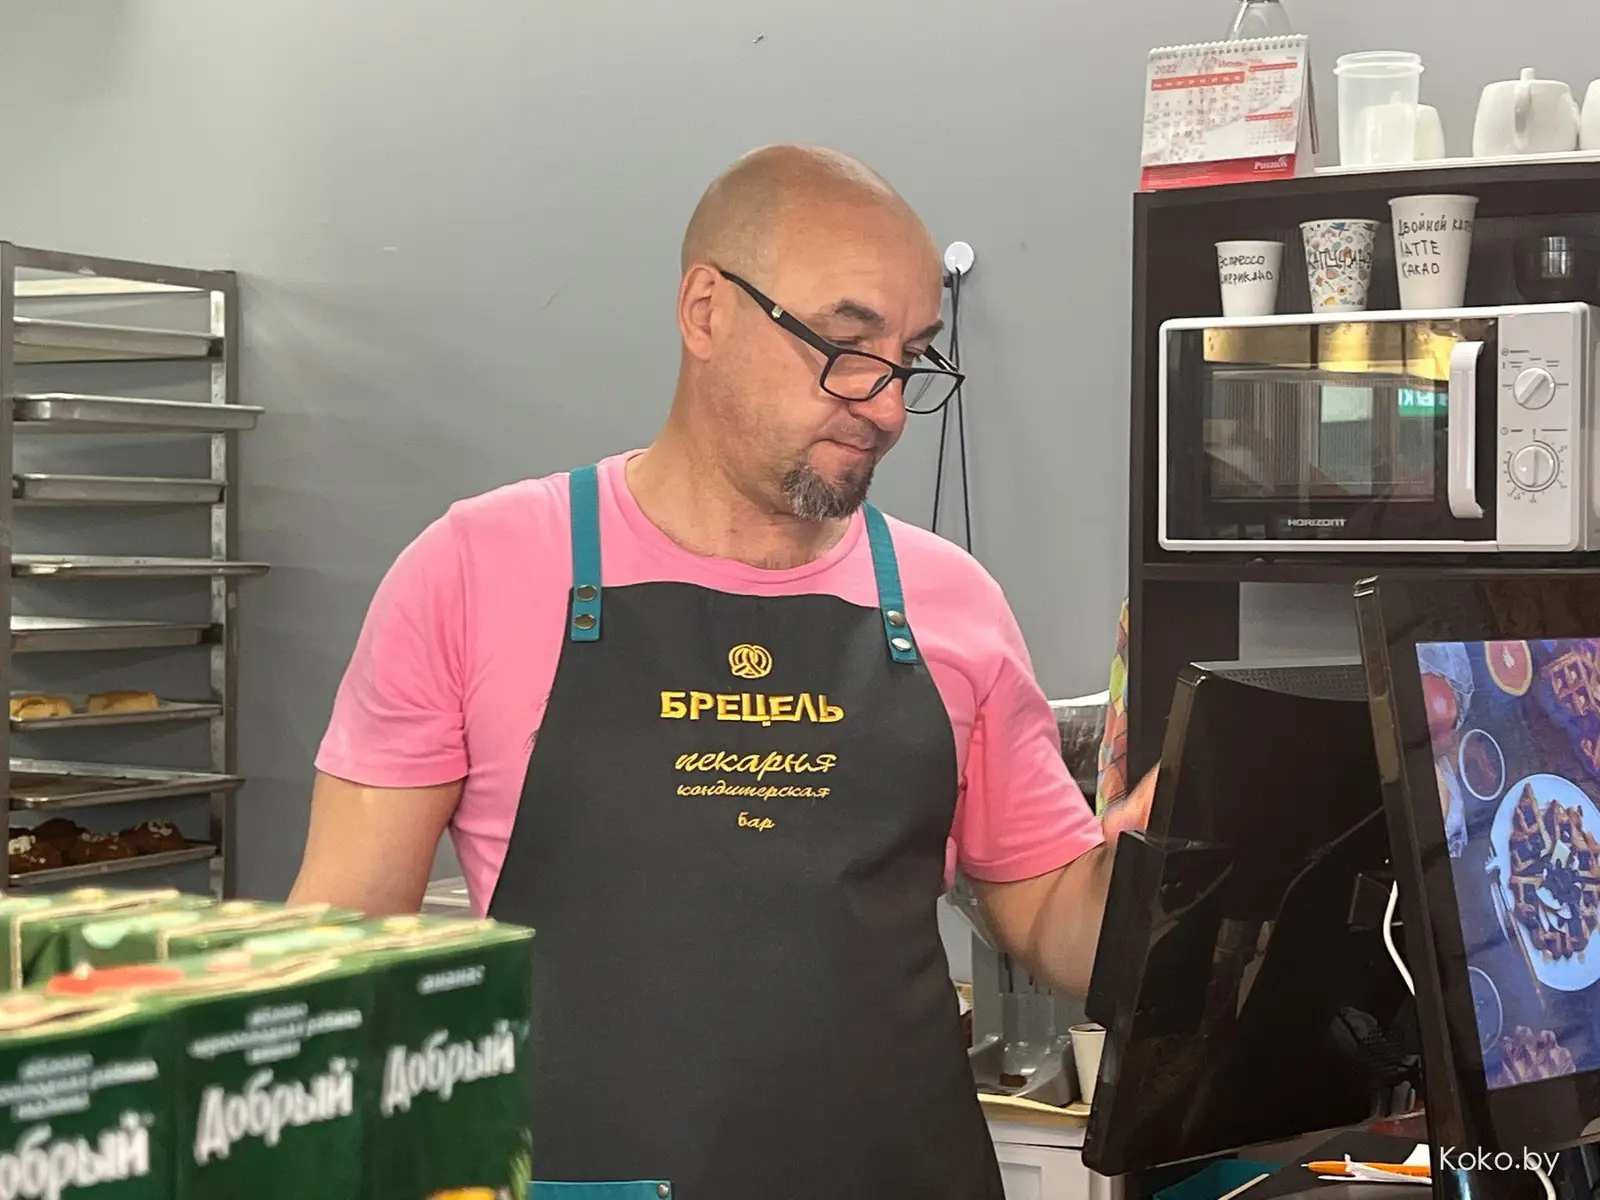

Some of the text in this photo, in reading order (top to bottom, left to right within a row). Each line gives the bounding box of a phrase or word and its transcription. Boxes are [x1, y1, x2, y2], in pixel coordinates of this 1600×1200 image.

[1287, 518, 1347, 527] HORIZONT
[660, 690, 845, 727] БРЕЦЕЛЬ
[674, 750, 838, 781] пекарня
[677, 779, 831, 801] кондитерская
[380, 1019, 515, 1118] Добрый
[193, 1056, 354, 1167] Добрый
